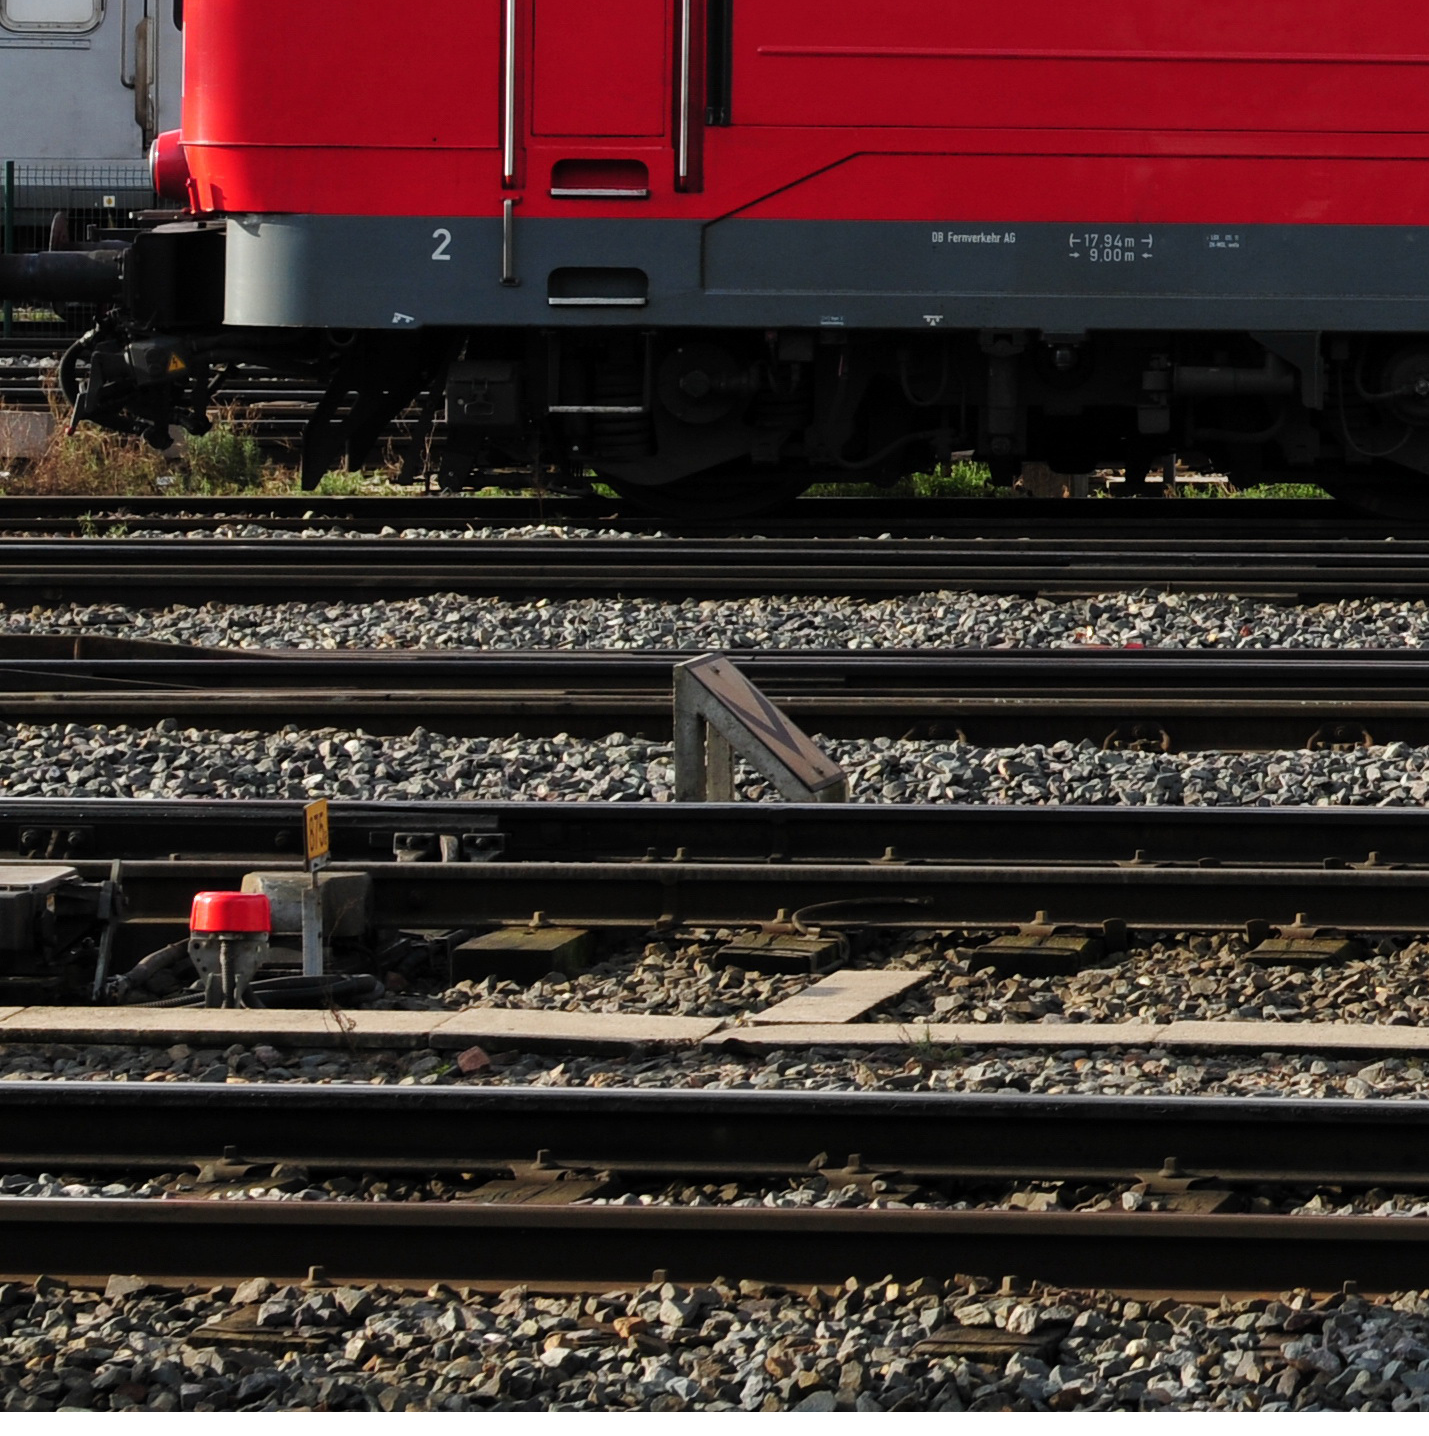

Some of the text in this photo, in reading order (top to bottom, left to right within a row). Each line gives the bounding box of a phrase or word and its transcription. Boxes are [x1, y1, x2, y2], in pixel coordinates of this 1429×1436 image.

[430, 228, 452, 261] 2
[932, 232, 1016, 243] DB Fernverkehr AG
